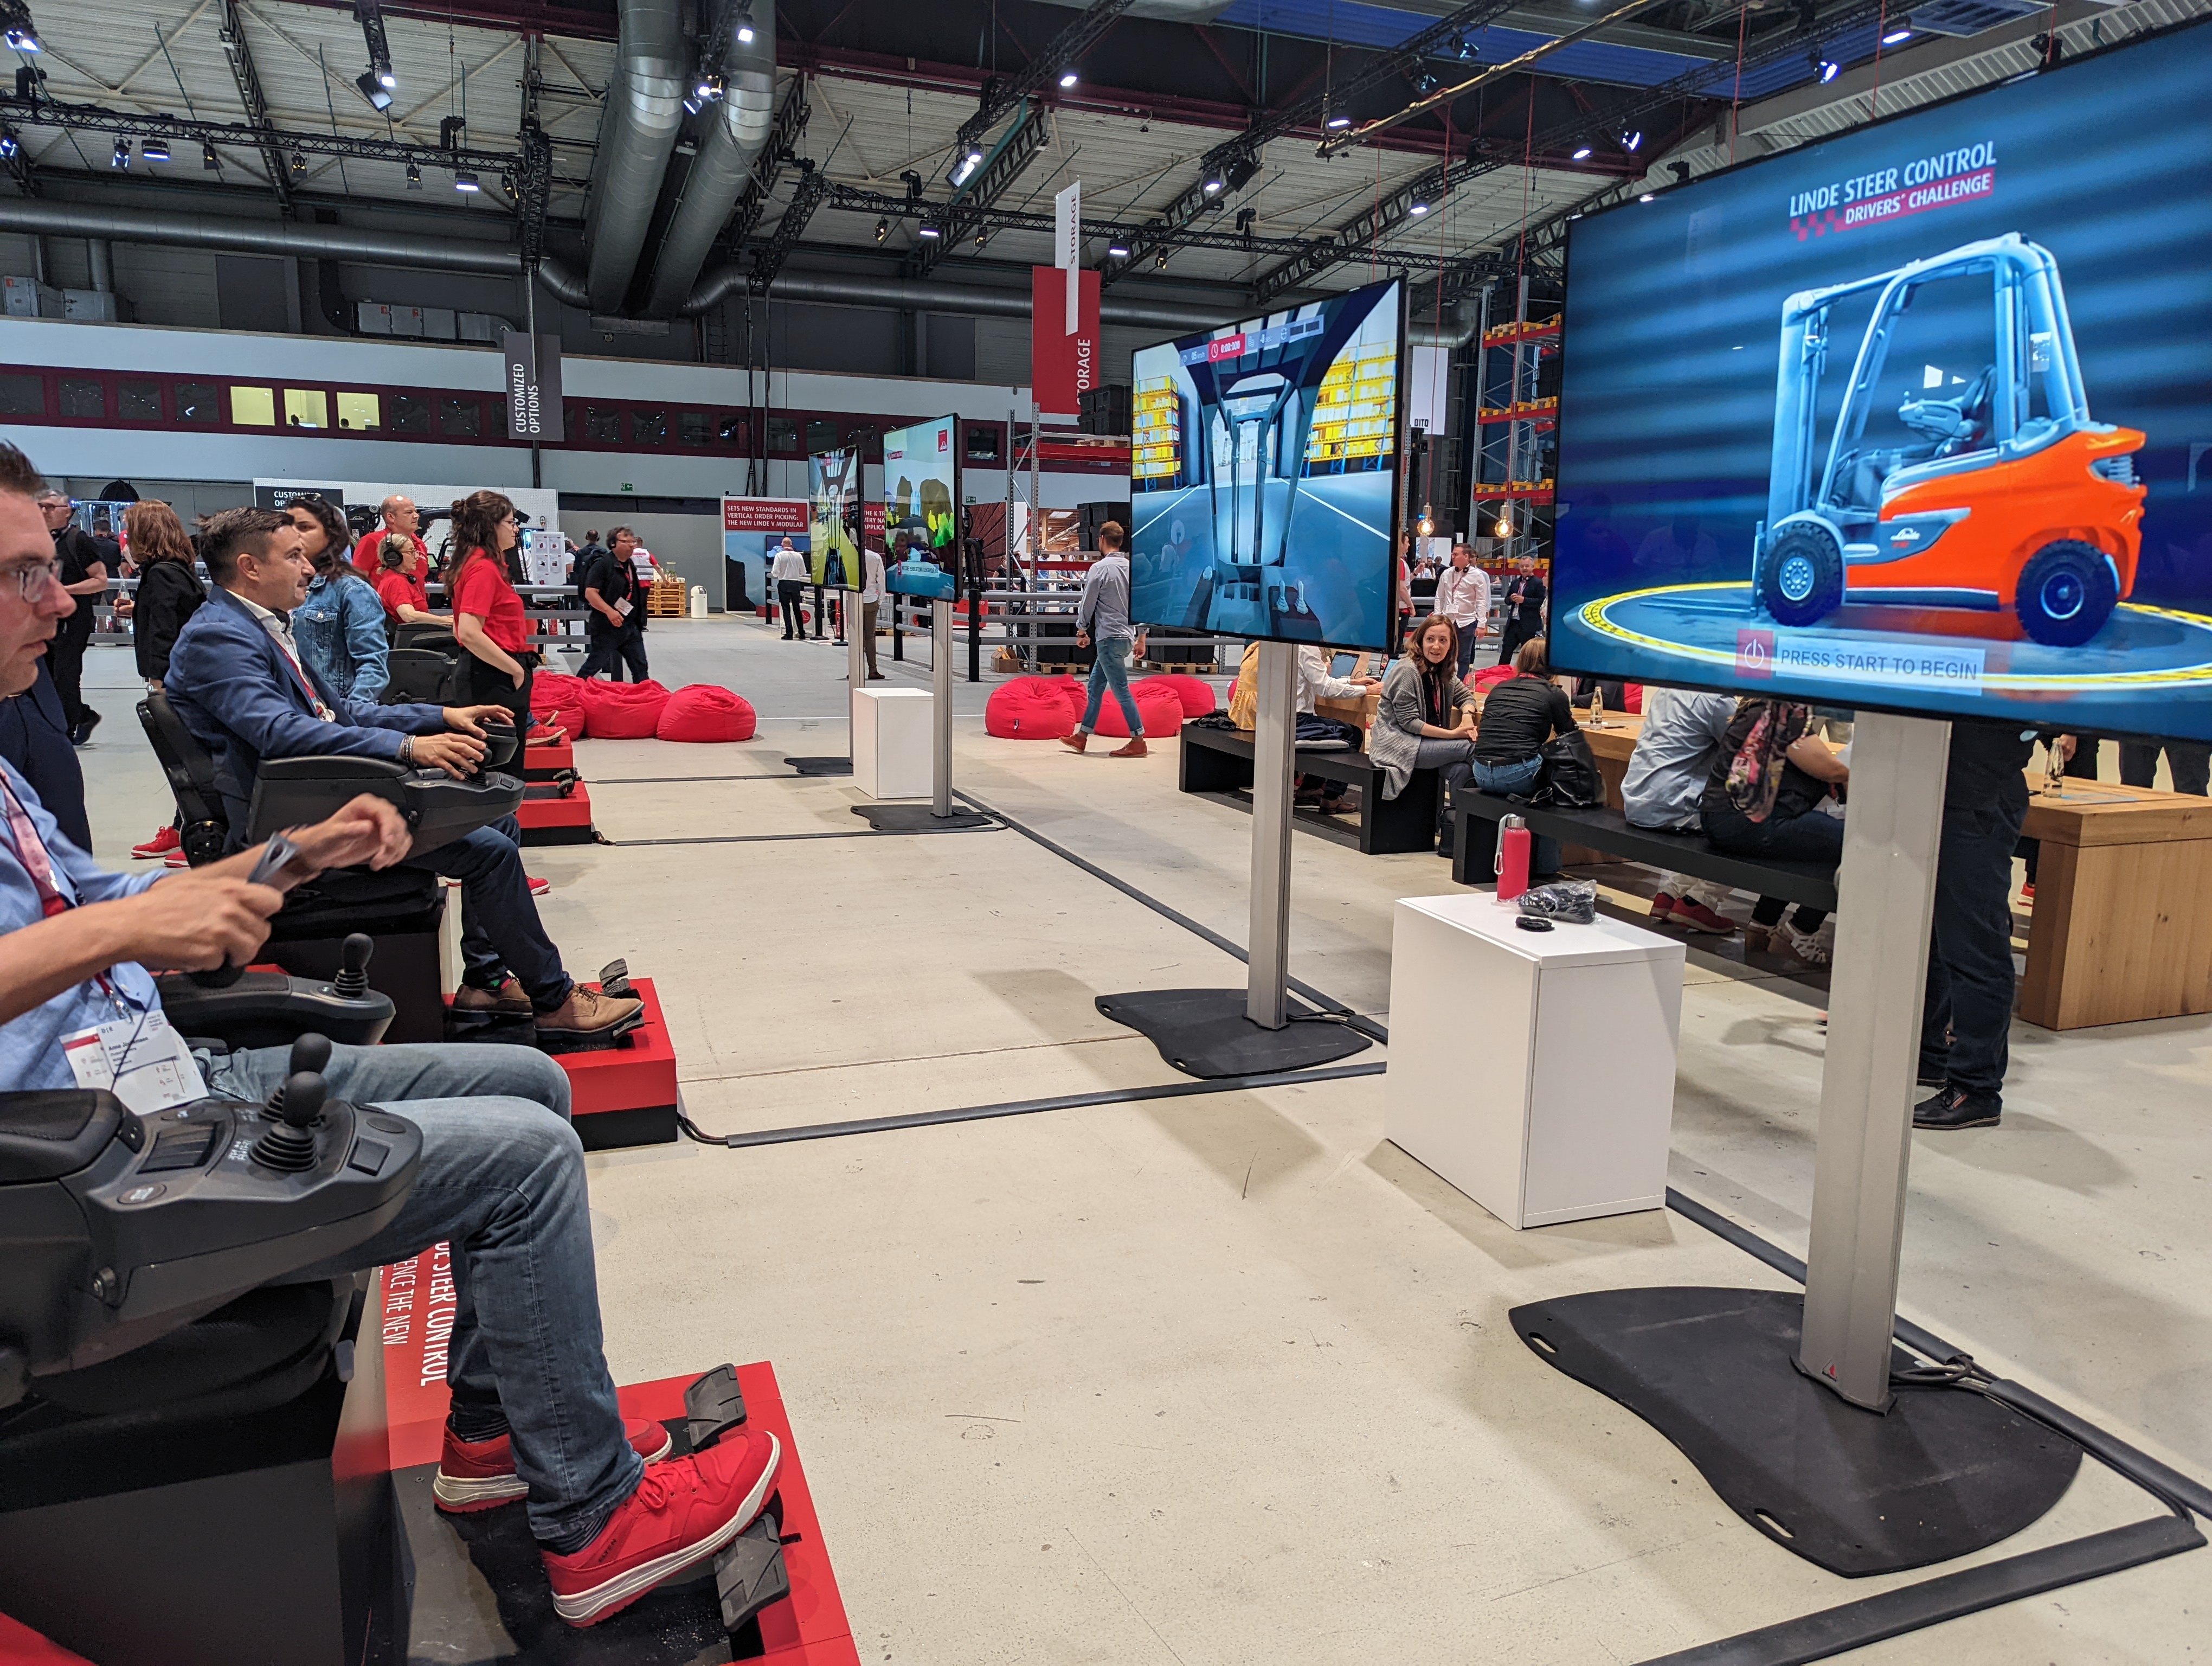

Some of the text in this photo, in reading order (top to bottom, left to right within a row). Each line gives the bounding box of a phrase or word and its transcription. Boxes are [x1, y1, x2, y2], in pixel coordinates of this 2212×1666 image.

[1790, 140, 1997, 217] LINDE STEER CONTROL
[1908, 172, 1991, 209] CHALLENGE
[513, 363, 526, 433] CUSTOMIZED
[528, 385, 541, 433] OPTIONS
[1414, 418, 1429, 427] BITO
[1781, 649, 1977, 680] PRESS START TO BEGIN
[386, 1289, 414, 1313] THE
[383, 1314, 411, 1345] NEW
[420, 1307, 456, 1387] CONTROL
